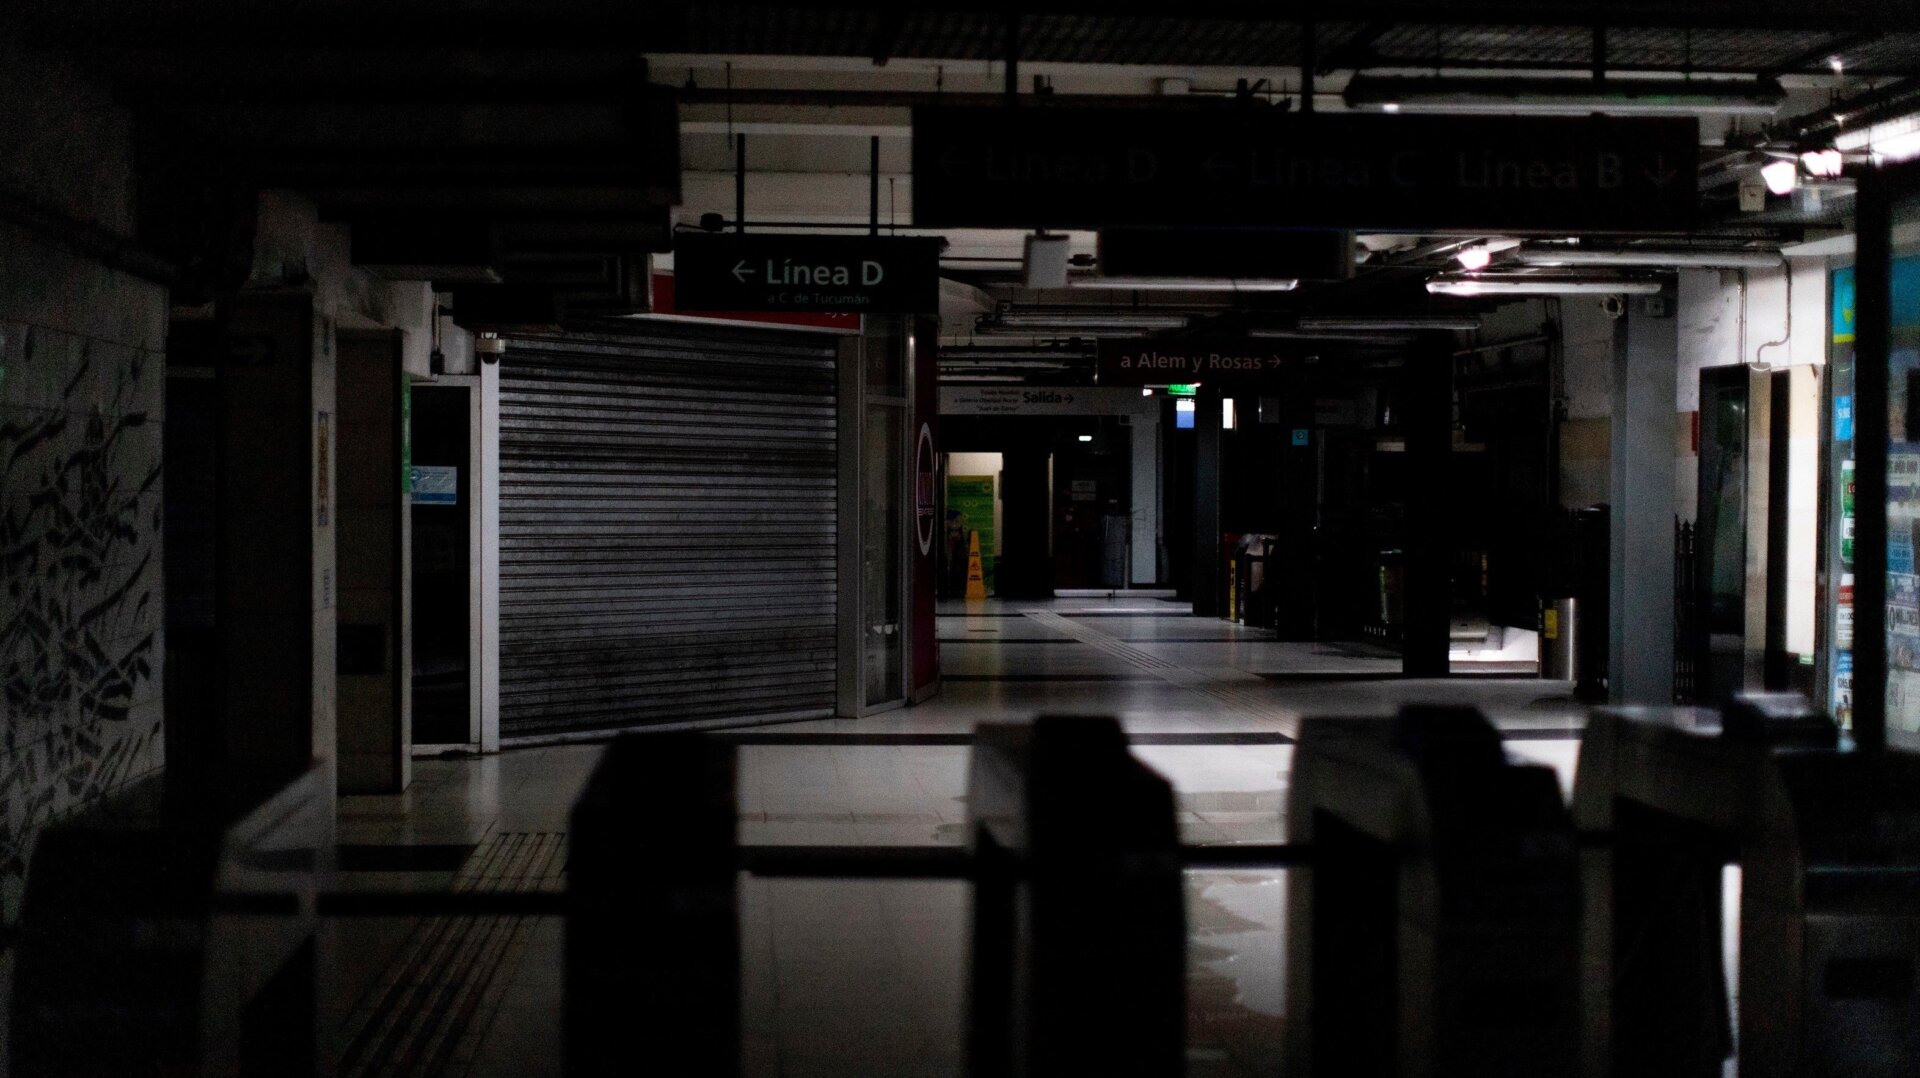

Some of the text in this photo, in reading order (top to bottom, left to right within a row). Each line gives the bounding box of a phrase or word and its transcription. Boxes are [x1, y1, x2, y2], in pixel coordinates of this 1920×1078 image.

[1456, 147, 1623, 190] Línea B
[766, 258, 885, 286] Línea D
[767, 294, 775, 304] a
[794, 292, 809, 304] de
[812, 292, 870, 304] Tucumán
[1120, 353, 1263, 372] a Alem y Rosas
[1023, 391, 1062, 404] Salida
